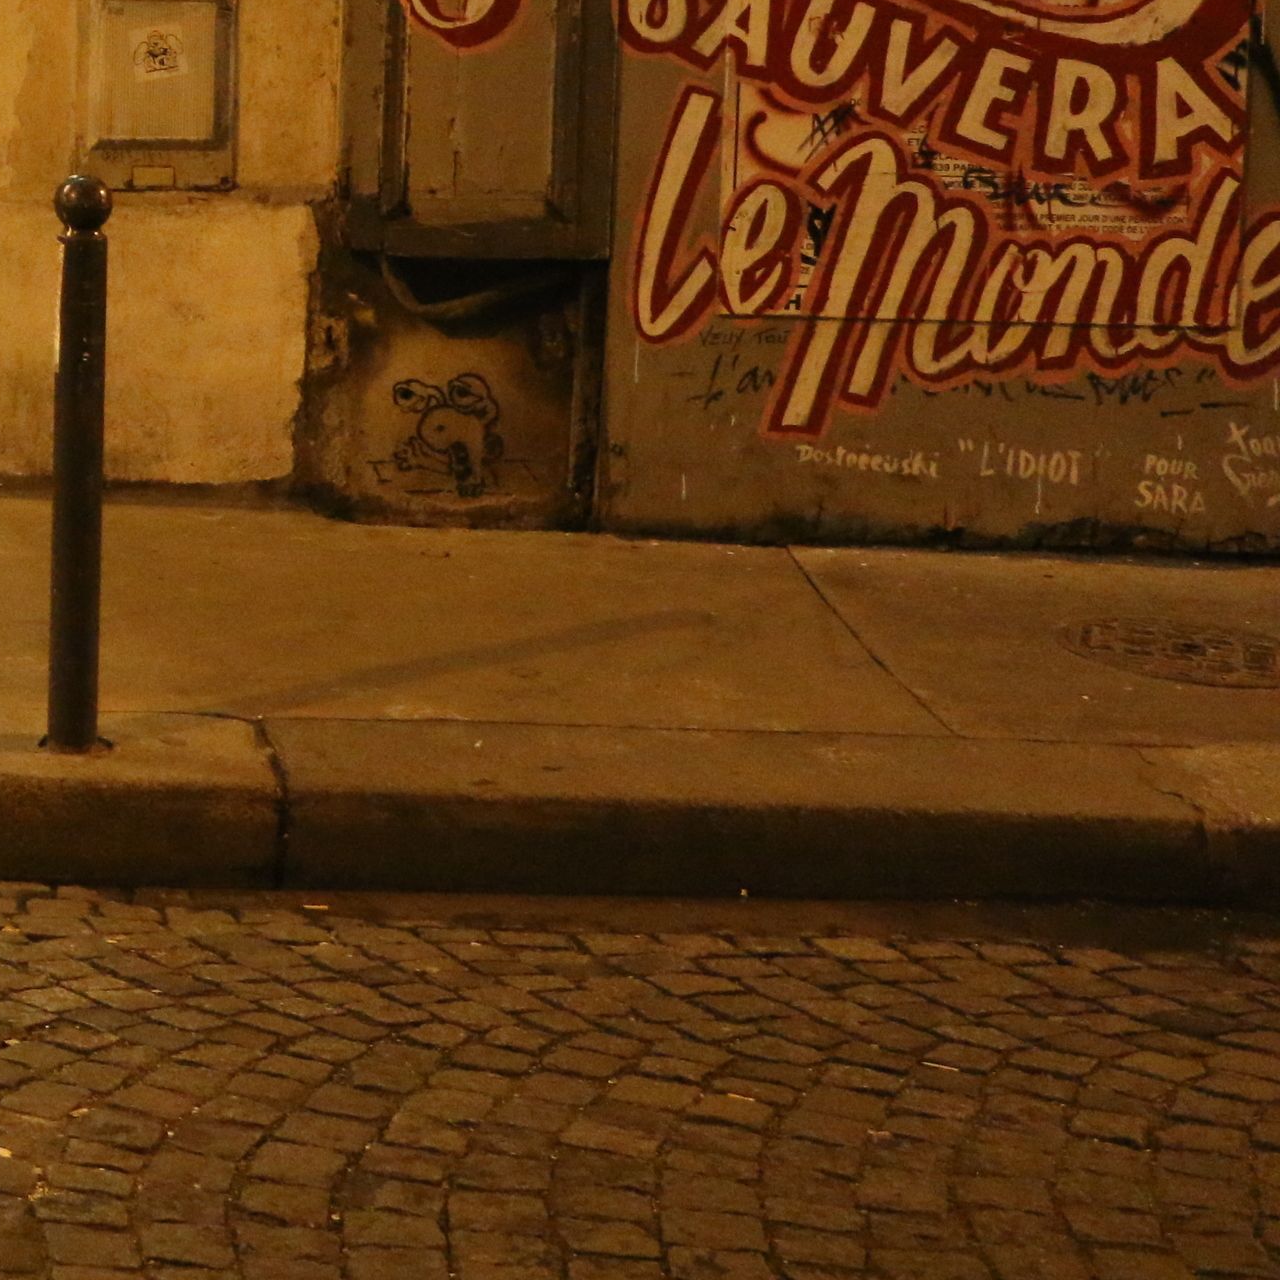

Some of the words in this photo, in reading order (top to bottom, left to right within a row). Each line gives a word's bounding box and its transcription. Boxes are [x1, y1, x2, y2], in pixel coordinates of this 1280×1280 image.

[632, 86, 798, 342] Le
[770, 132, 1280, 432] Monde
[1144, 453, 1200, 480] POUR
[1134, 480, 1206, 515] SARA
